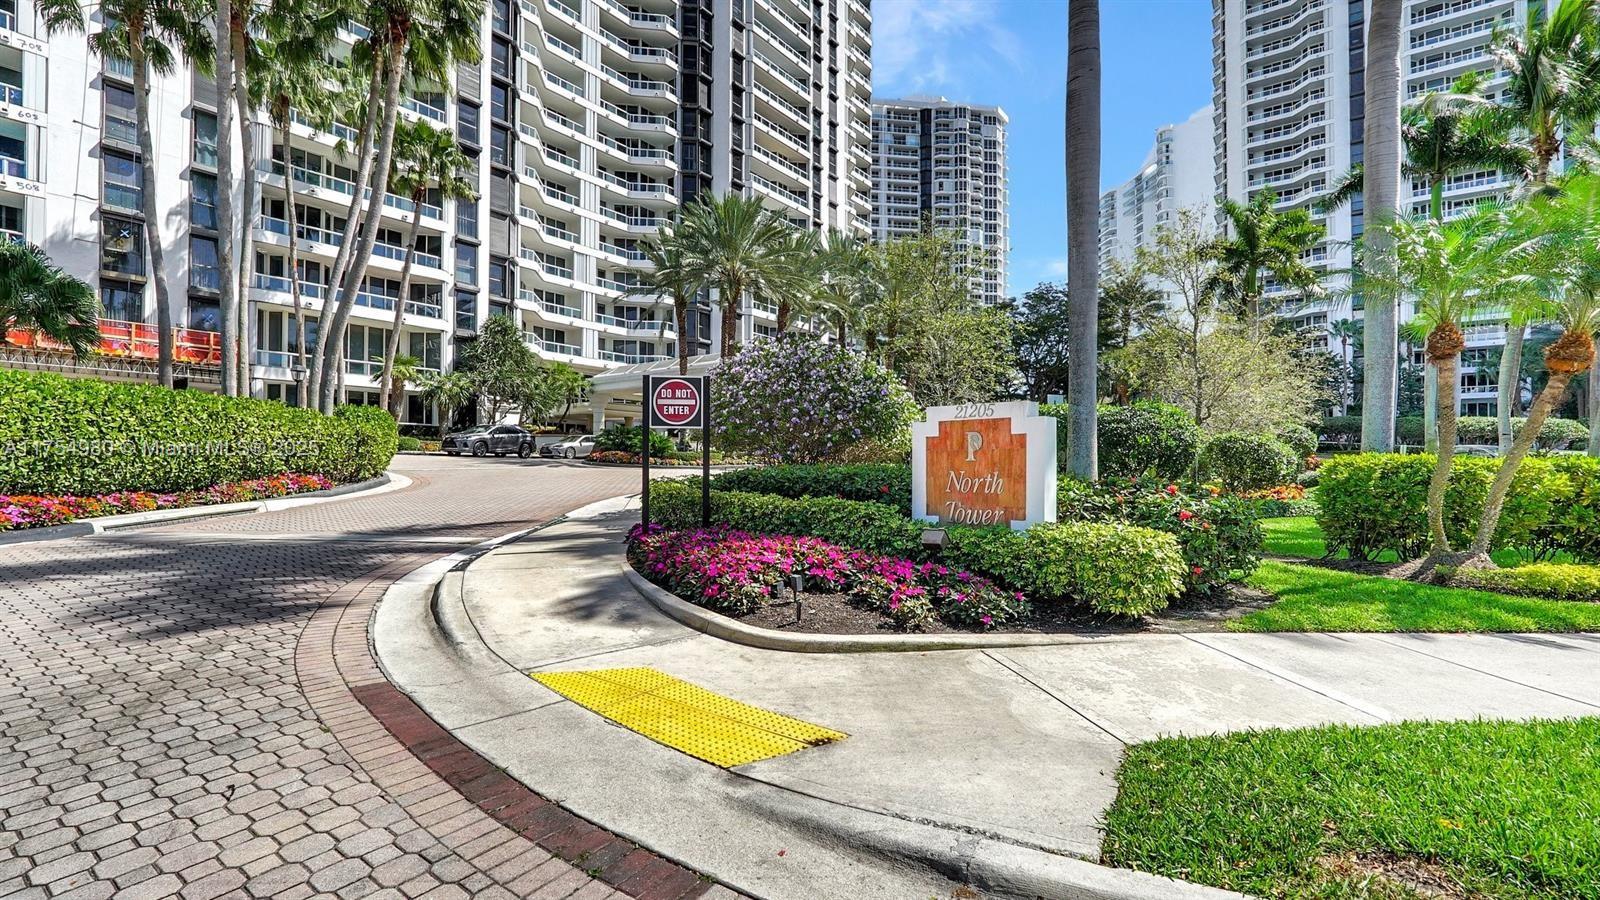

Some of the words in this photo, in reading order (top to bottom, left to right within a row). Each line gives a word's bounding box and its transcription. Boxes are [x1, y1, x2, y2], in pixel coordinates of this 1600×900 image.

[661, 389, 672, 398] DO
[675, 389, 692, 398] NOT
[663, 405, 690, 415] ENTER
[954, 403, 995, 419] 21205
[945, 470, 1004, 495] North
[945, 501, 1005, 525] Tower
